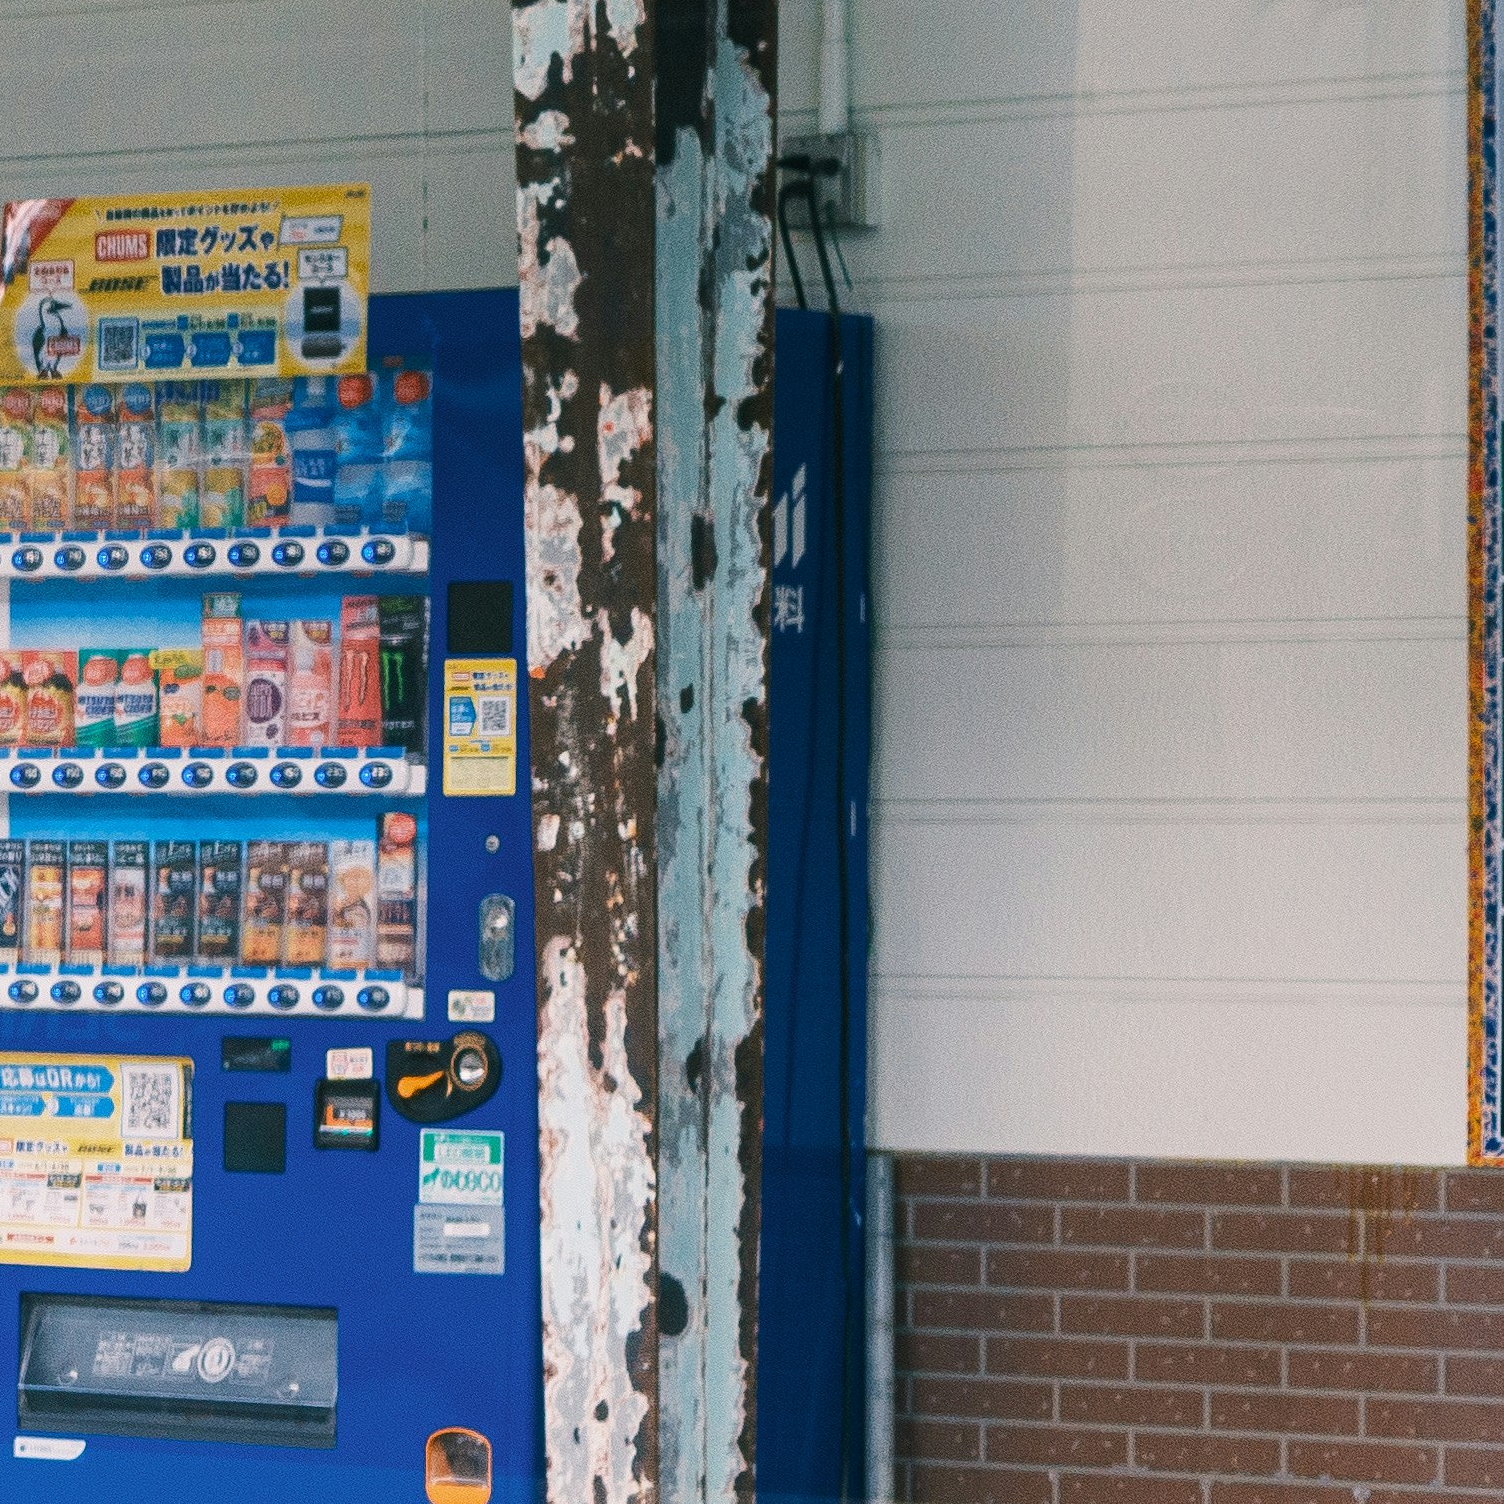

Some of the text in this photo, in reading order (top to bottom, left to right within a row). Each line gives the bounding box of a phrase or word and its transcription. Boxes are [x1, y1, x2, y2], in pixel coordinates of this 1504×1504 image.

[97, 232, 149, 260] CHUMS
[161, 260, 291, 295] 製品が当たる!
